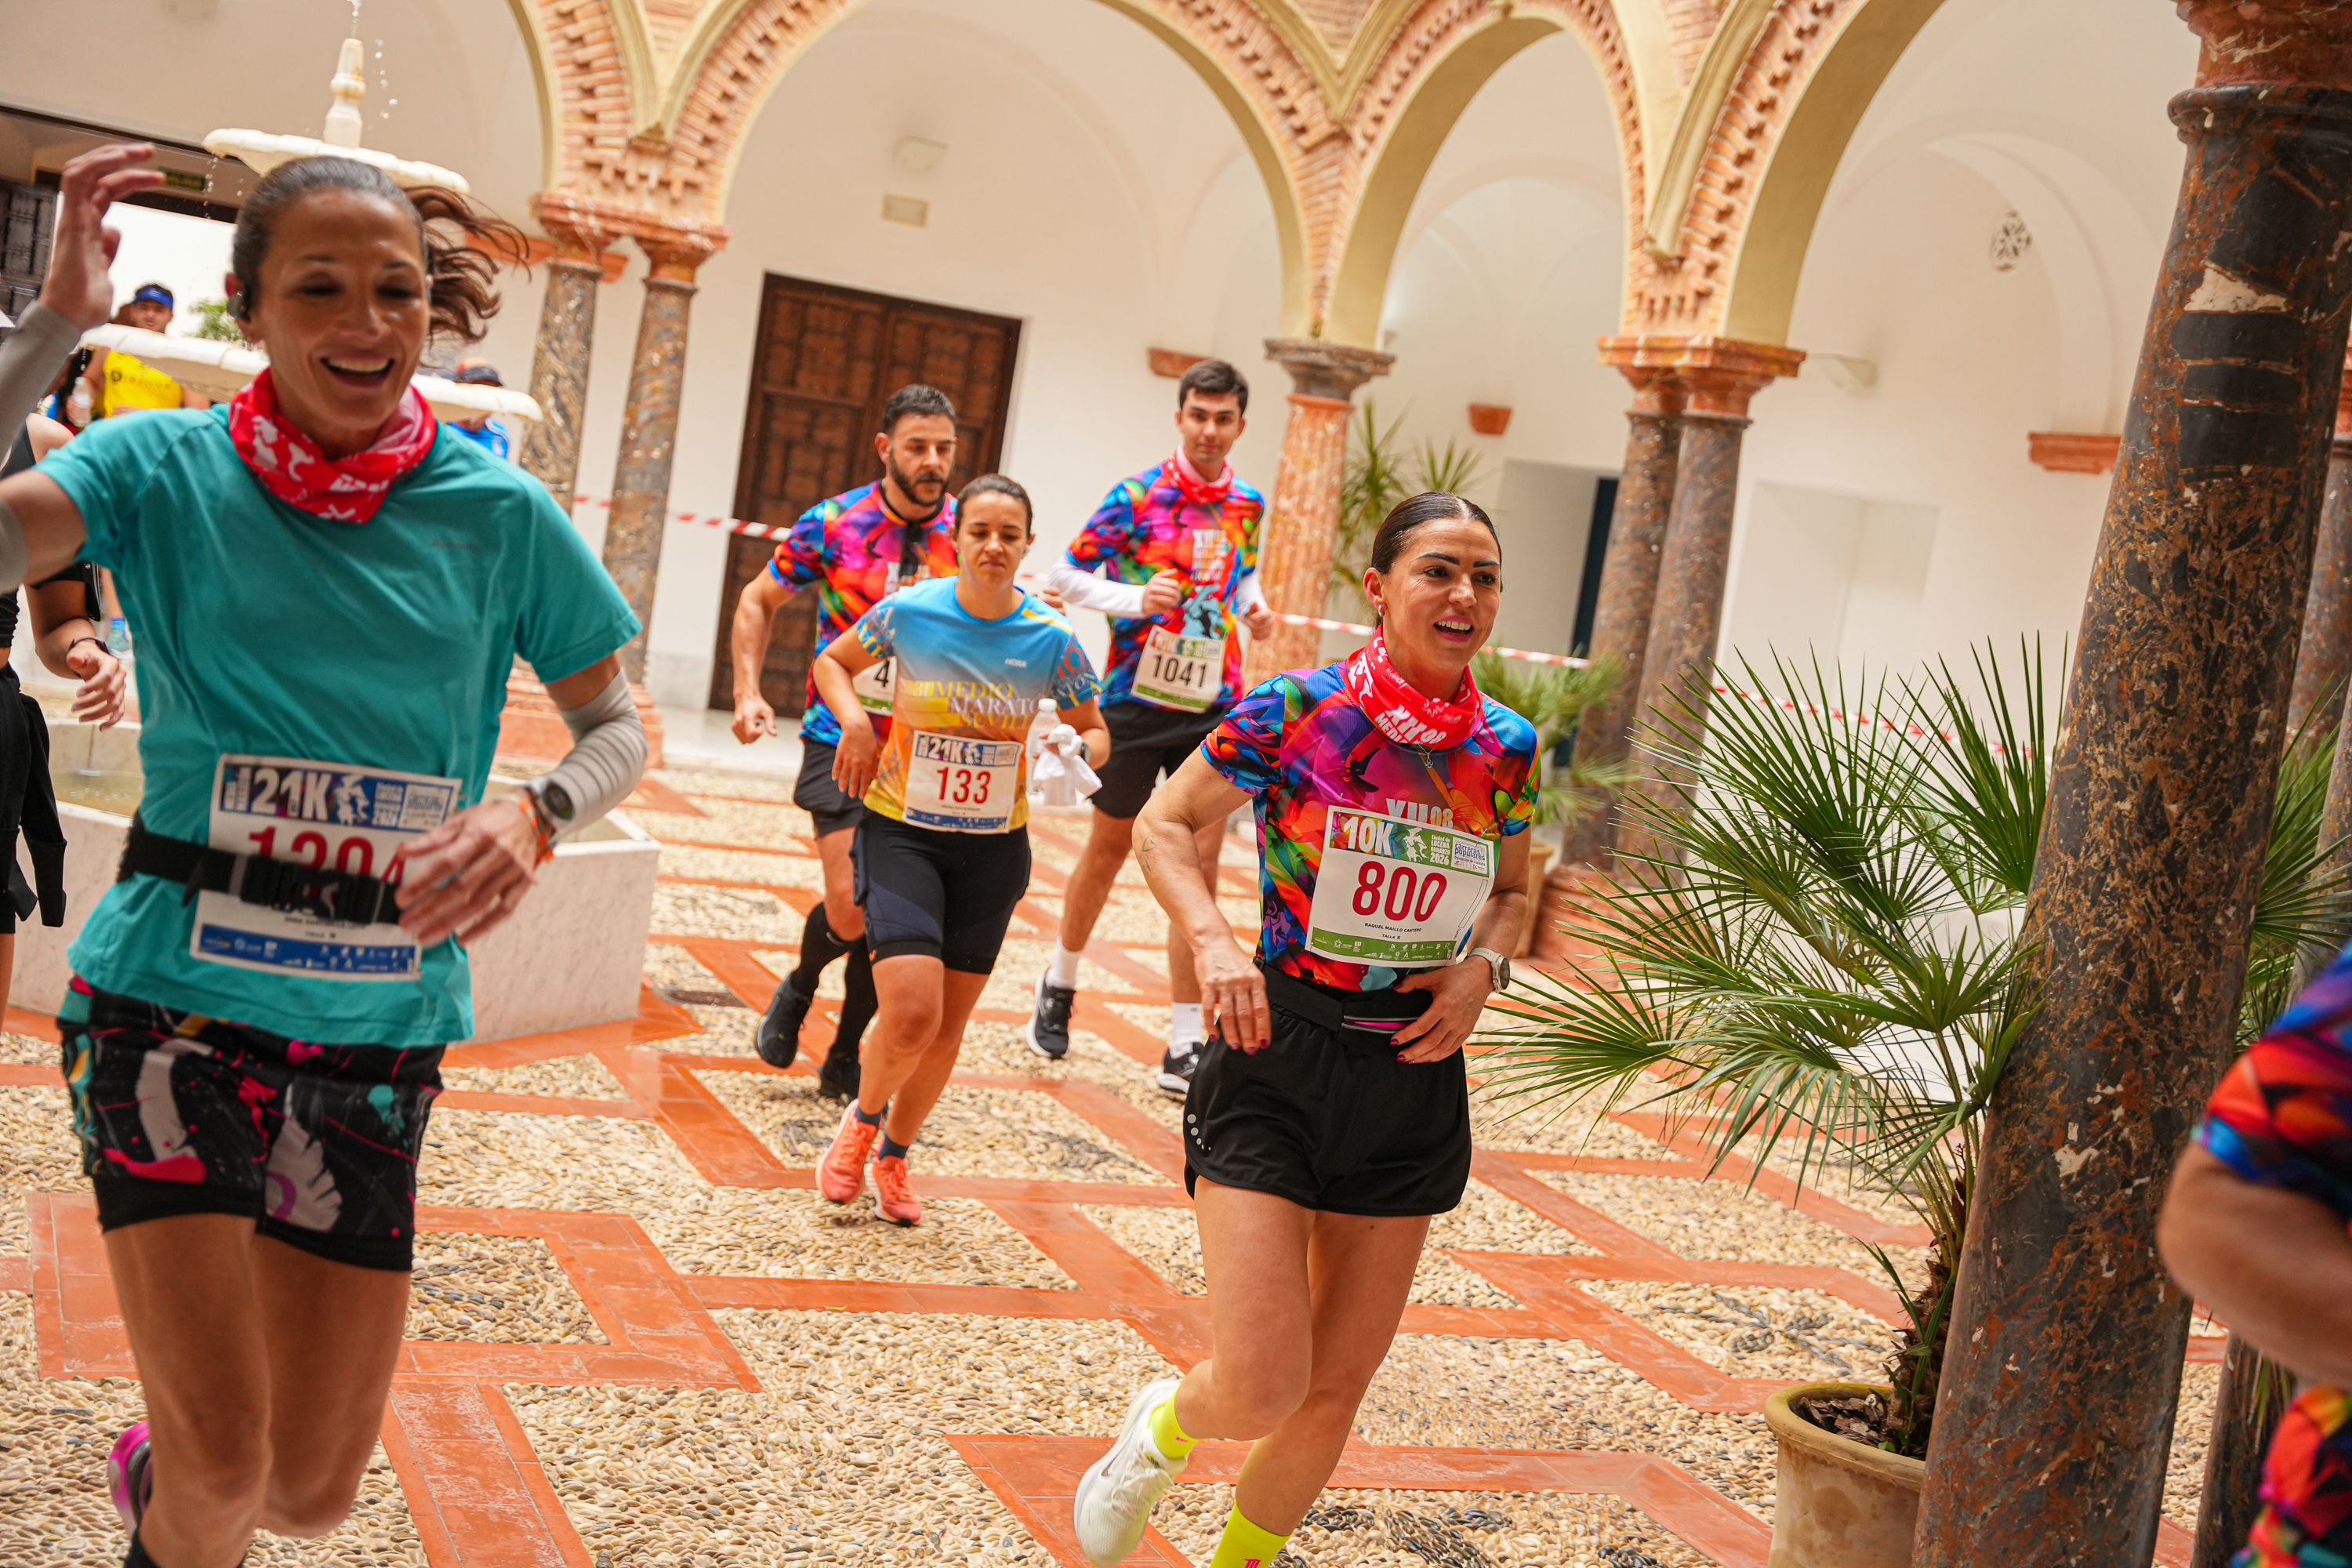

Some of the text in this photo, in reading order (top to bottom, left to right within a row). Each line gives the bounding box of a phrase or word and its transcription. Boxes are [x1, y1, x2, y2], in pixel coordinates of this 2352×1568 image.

[1153, 654, 1207, 688] 1041
[933, 681, 1014, 699] MEDIO
[949, 697, 1040, 716] MARAT
[928, 736, 964, 763] 21K
[252, 768, 332, 821] 21K
[937, 767, 991, 804] 133
[1344, 816, 1394, 856] 10K
[1431, 839, 1450, 849] LUCENA
[1430, 852, 1450, 866] 2026
[1454, 843, 1481, 855] carreras
[1454, 848, 1486, 861] populares
[1352, 860, 1447, 922] 800
